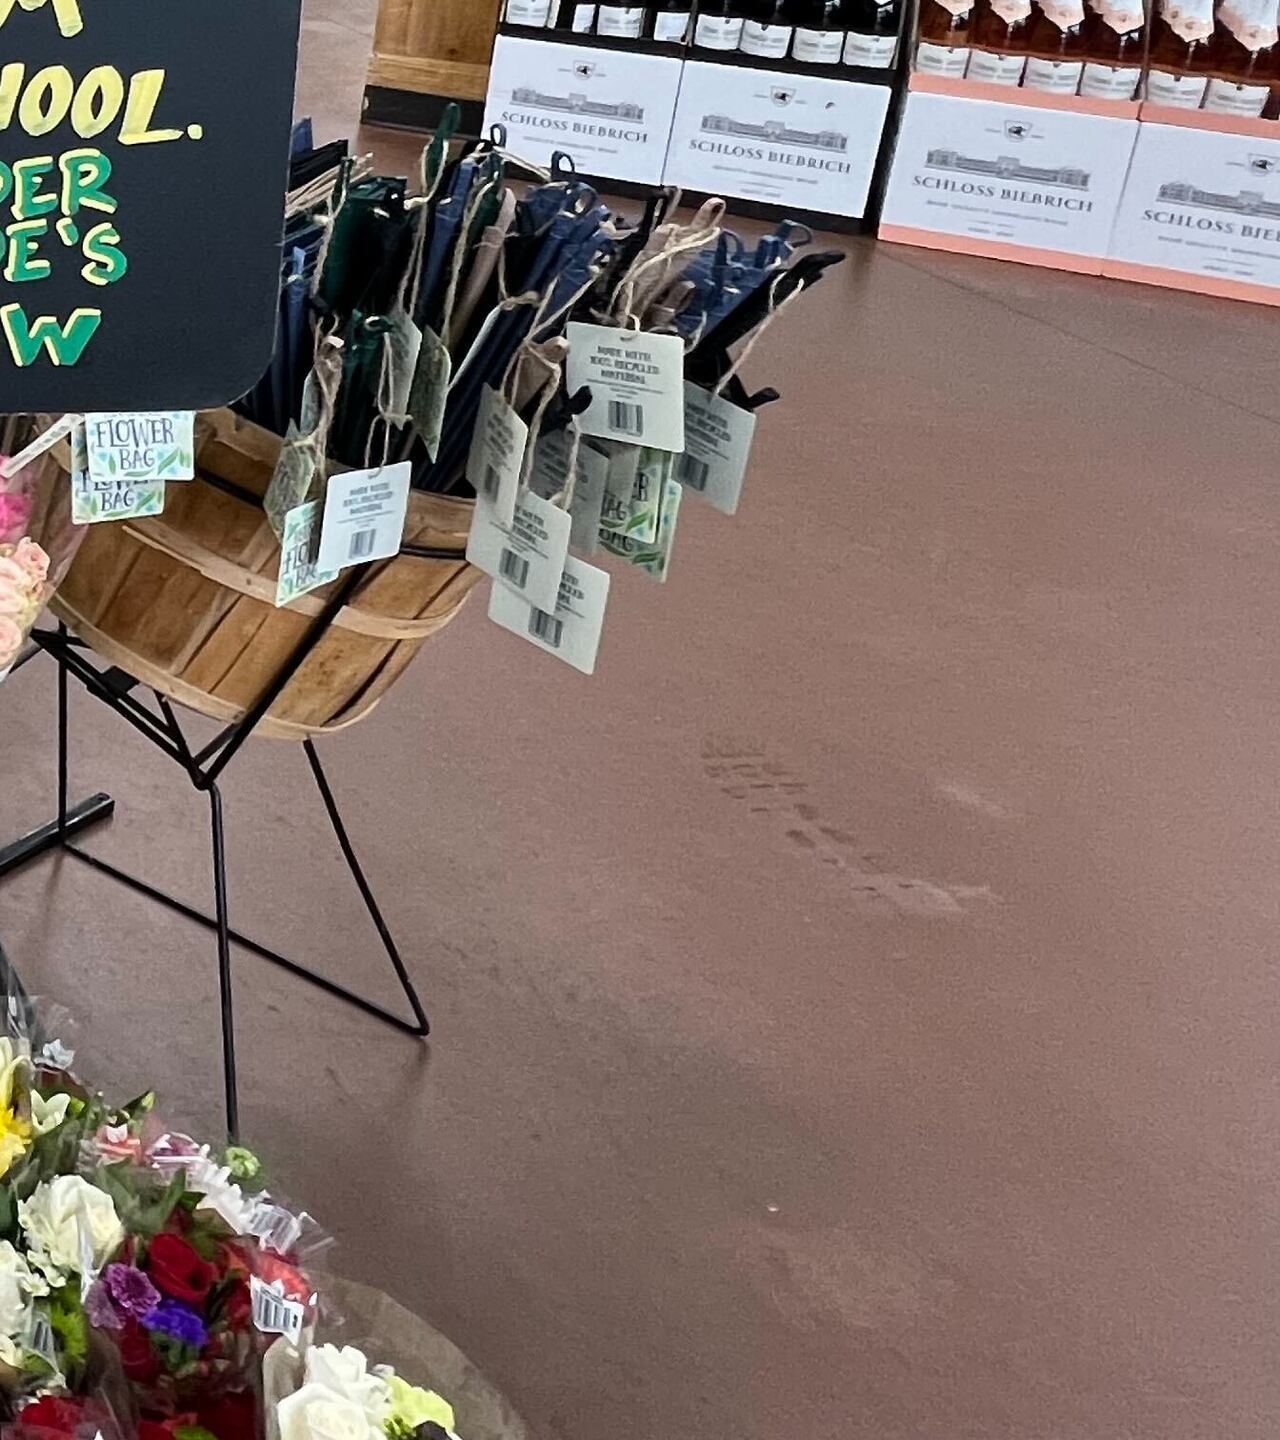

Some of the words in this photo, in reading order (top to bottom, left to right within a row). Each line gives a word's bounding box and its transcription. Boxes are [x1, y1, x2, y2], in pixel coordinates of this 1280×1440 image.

[500, 111, 569, 132] SCHLOSS
[572, 123, 649, 144] BIEBRICH
[688, 139, 764, 160] SCHLOSS
[767, 151, 852, 175] BIEBRICH
[911, 174, 995, 198] SCHLOSS
[1000, 188, 1094, 212] BIEBRICH
[1141, 209, 1235, 234] SCHLOSS
[95, 417, 174, 449] FLOWER
[118, 448, 155, 470] BAG
[101, 488, 135, 512] BAG
